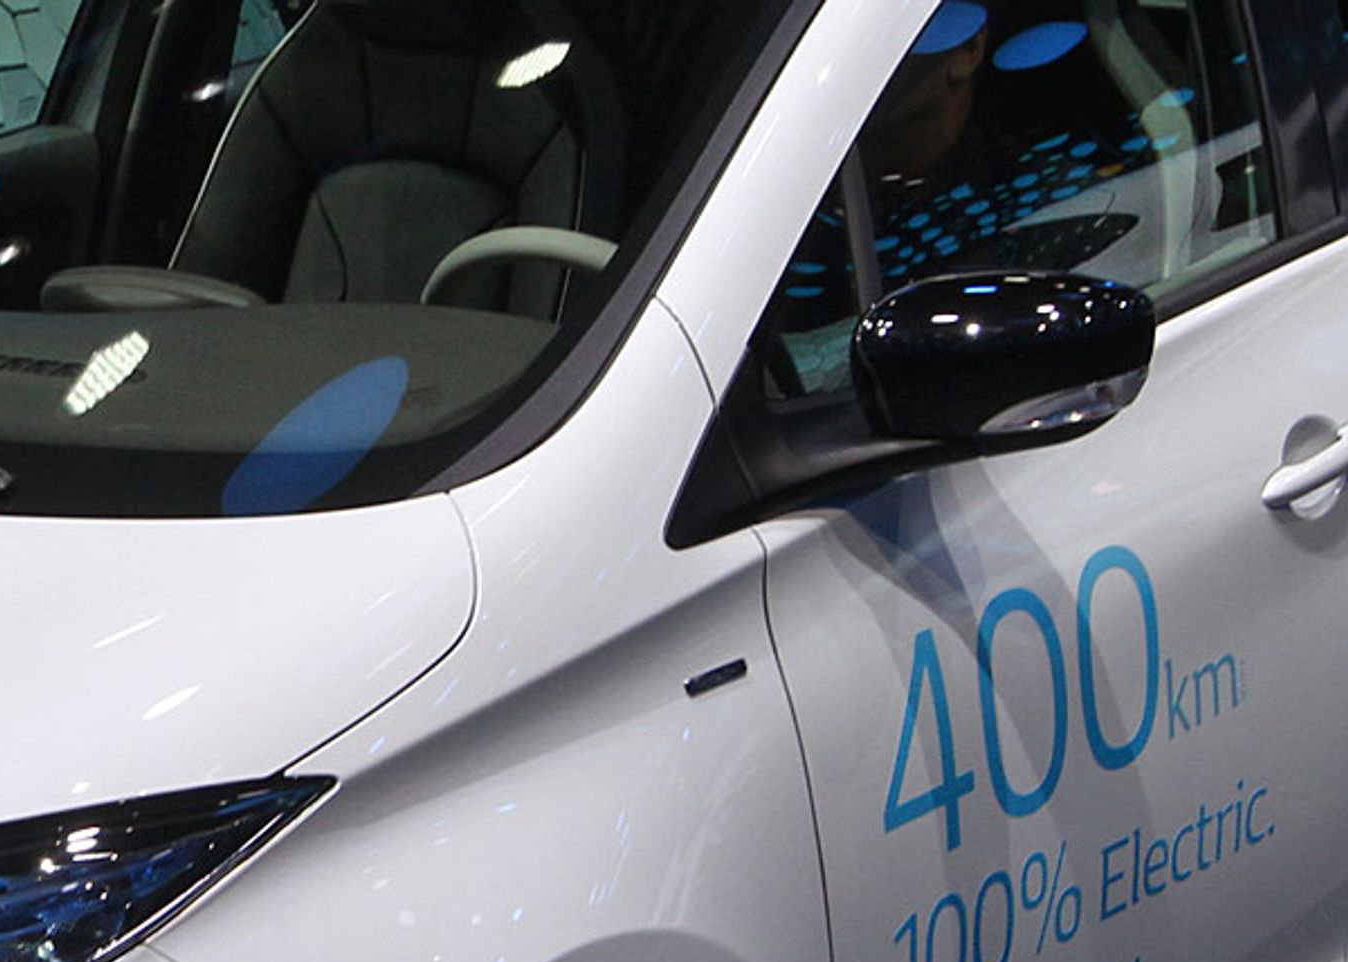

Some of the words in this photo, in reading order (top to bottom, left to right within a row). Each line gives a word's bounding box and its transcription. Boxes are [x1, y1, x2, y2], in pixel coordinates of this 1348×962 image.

[883, 545, 1160, 853] 400
[1164, 652, 1240, 740] km
[1099, 779, 1276, 922] Electric.
